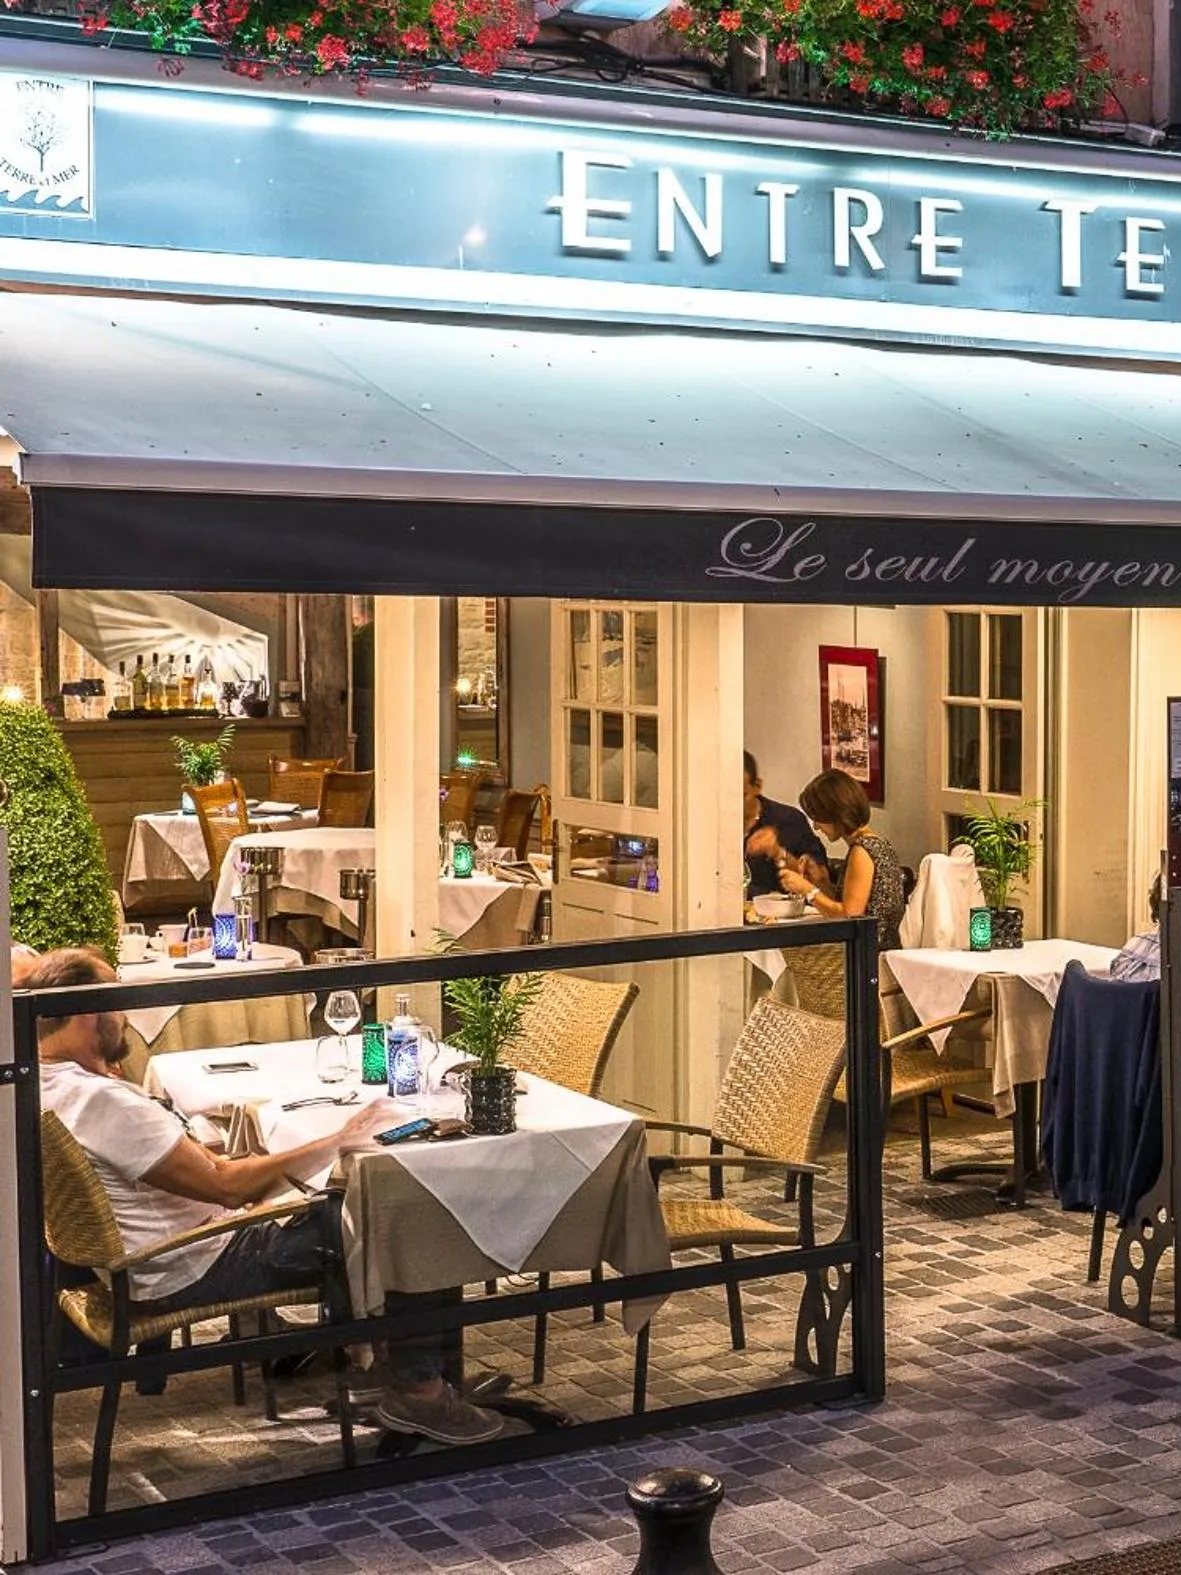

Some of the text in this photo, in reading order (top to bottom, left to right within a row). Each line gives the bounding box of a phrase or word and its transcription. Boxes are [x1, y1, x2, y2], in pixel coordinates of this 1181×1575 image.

[547, 150, 964, 278] ENTRE
[704, 516, 828, 583] Le
[845, 537, 977, 584] seul
[987, 555, 1181, 604] moyen
